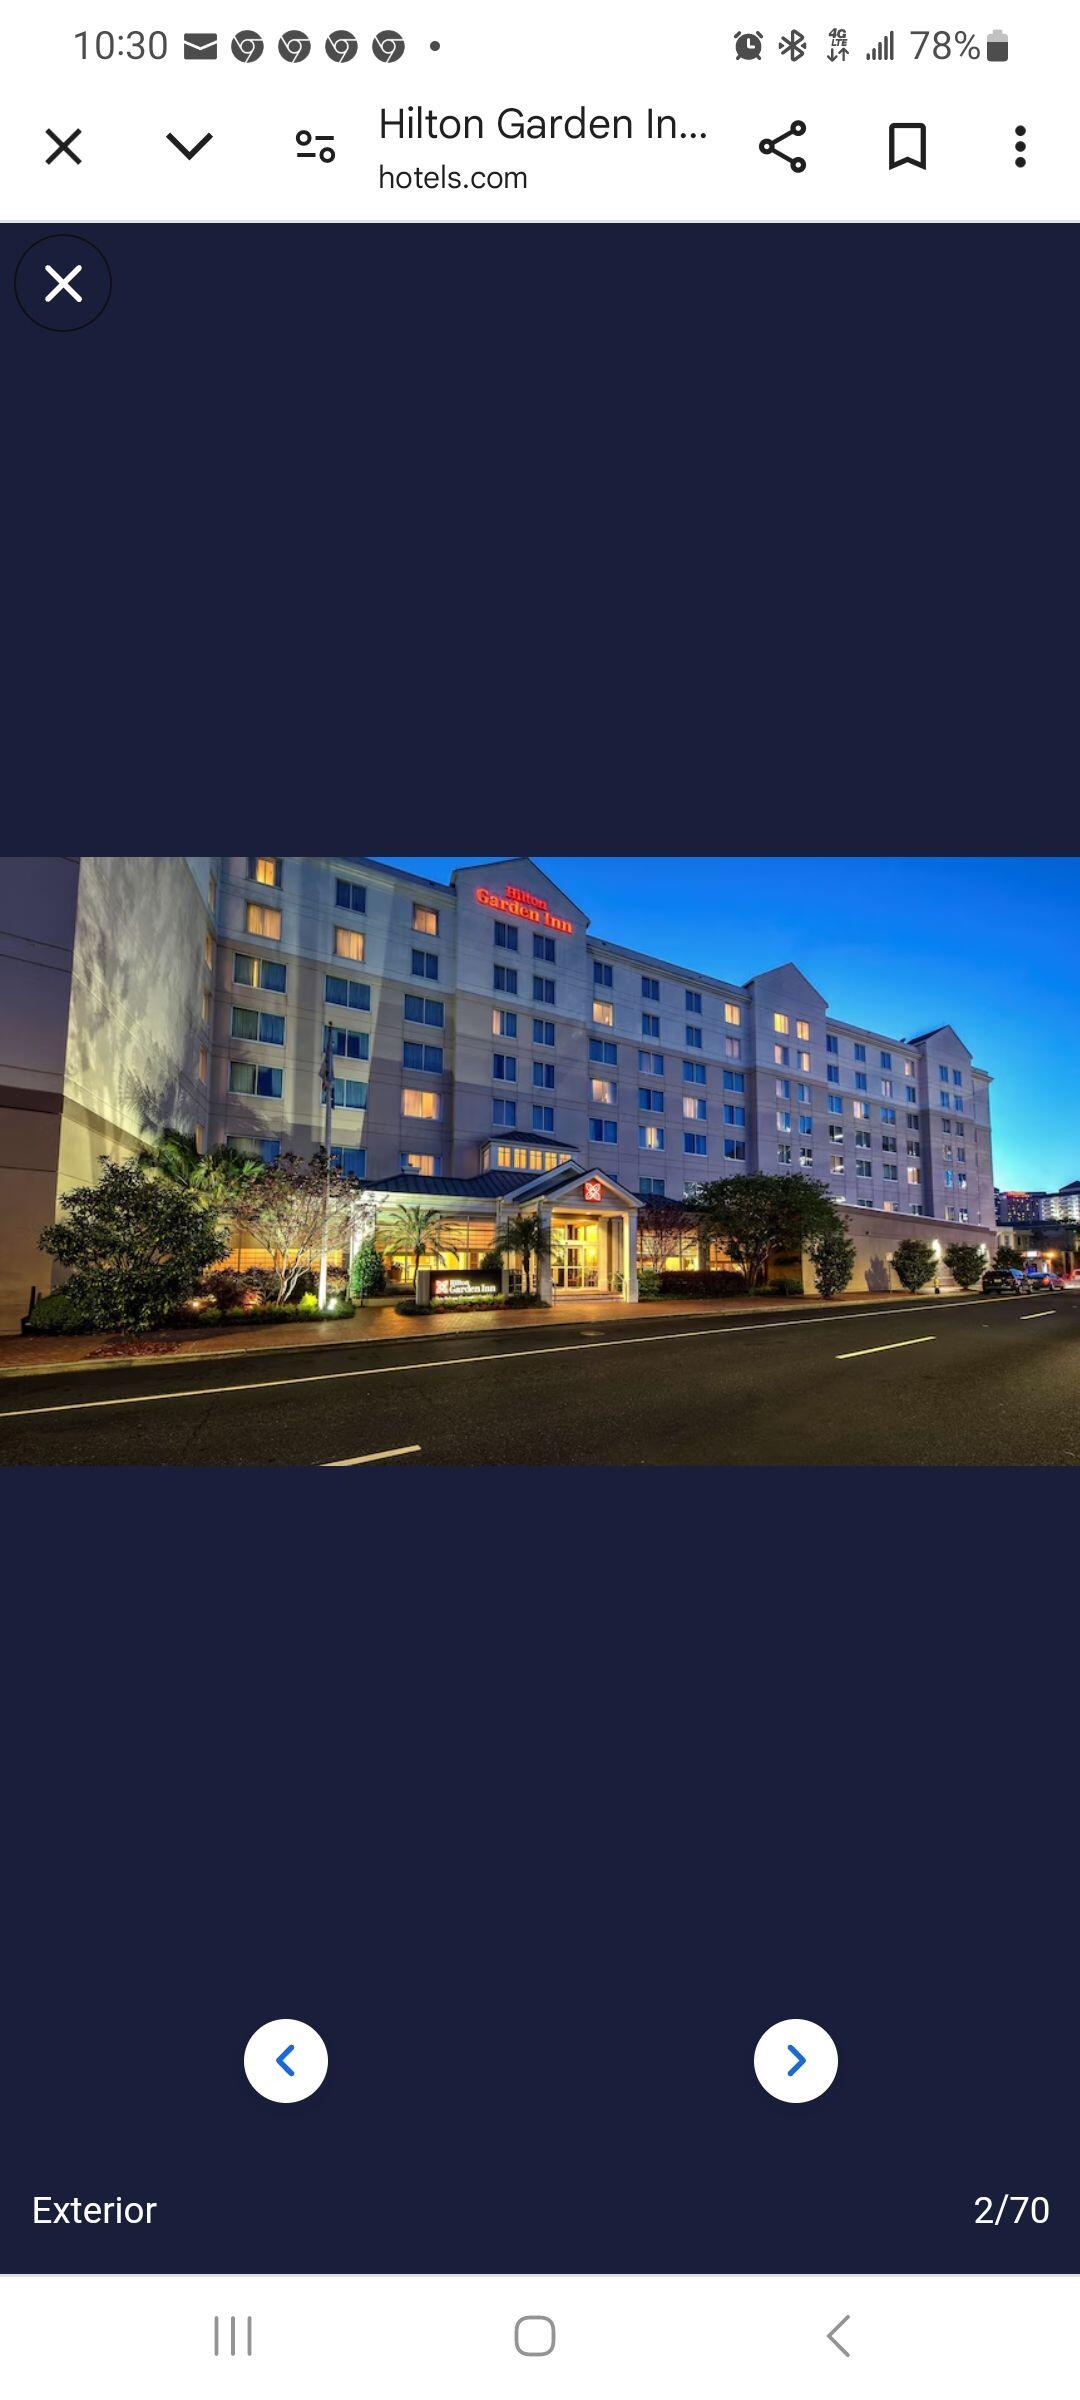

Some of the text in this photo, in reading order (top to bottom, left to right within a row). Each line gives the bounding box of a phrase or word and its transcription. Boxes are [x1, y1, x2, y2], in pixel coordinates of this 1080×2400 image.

[74, 30, 168, 60] 10:30
[828, 27, 847, 38] 4G
[831, 38, 848, 47] LTE
[910, 30, 981, 60] 78%
[380, 105, 707, 140] Hilton Garden In...
[379, 163, 527, 190] hotels.com
[475, 887, 573, 934] Garden Inn
[506, 884, 548, 910] Hilton
[449, 1284, 496, 1294] Garden Inn
[32, 2195, 158, 2225] Exterior
[973, 2193, 1051, 2226] 2/70
